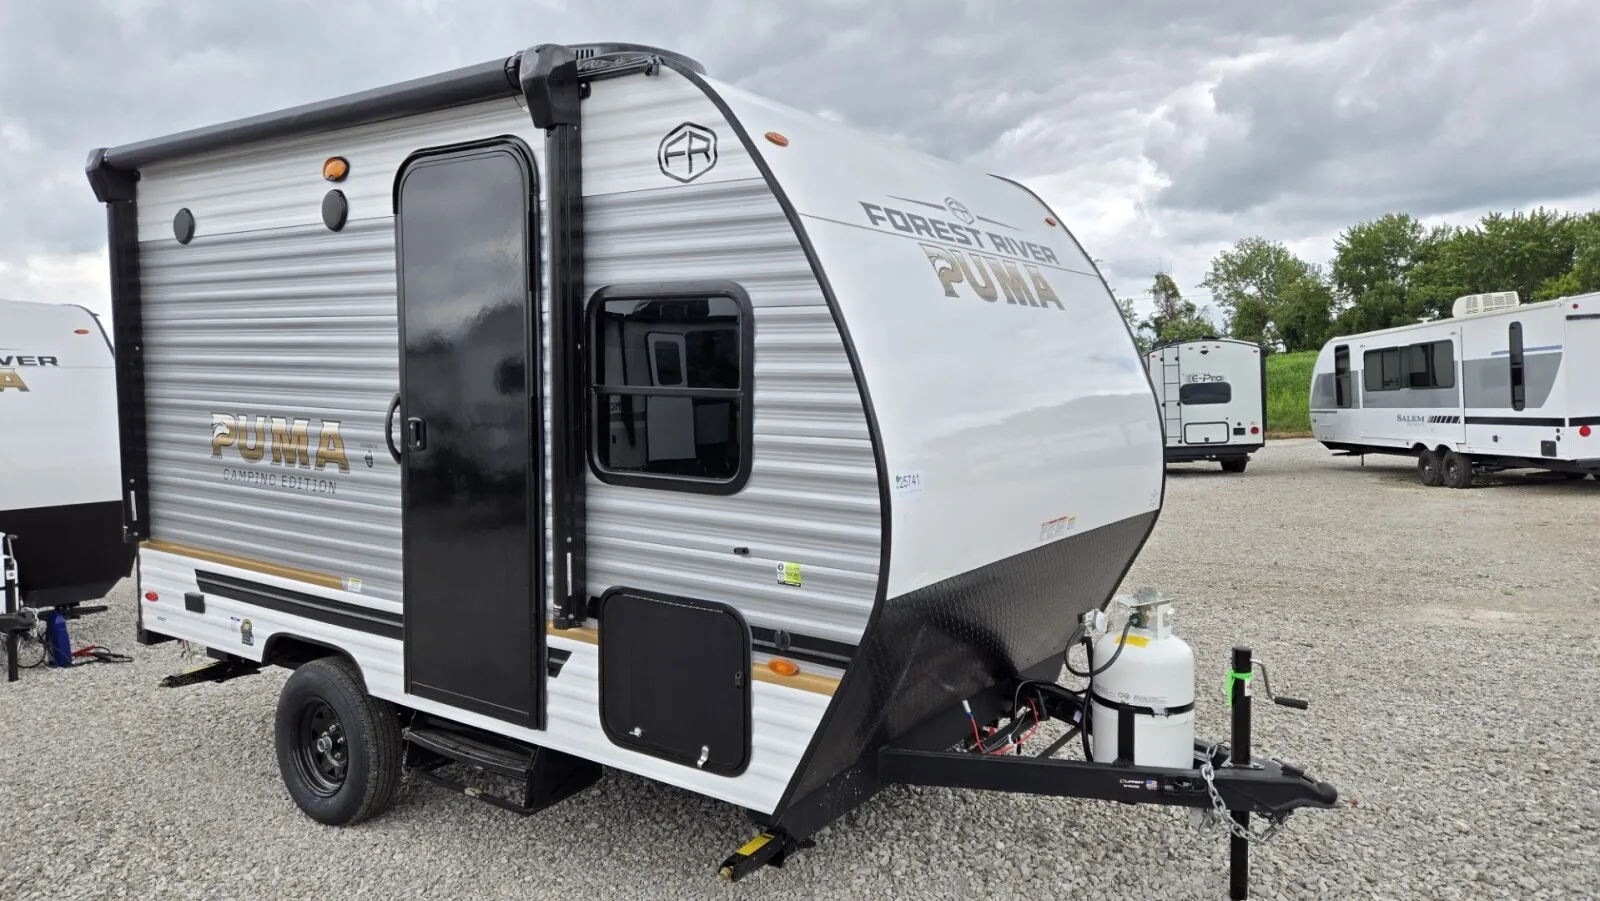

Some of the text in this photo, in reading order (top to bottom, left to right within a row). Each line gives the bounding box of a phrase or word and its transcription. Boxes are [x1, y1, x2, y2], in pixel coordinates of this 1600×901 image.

[859, 200, 1061, 265] FOREST RIVER
[918, 242, 1066, 311] PUMA
[1396, 414, 1425, 423] SALEM
[211, 412, 350, 474] PUMA
[223, 468, 337, 494] CAMPING EDITION
[899, 474, 920, 489] 25741
